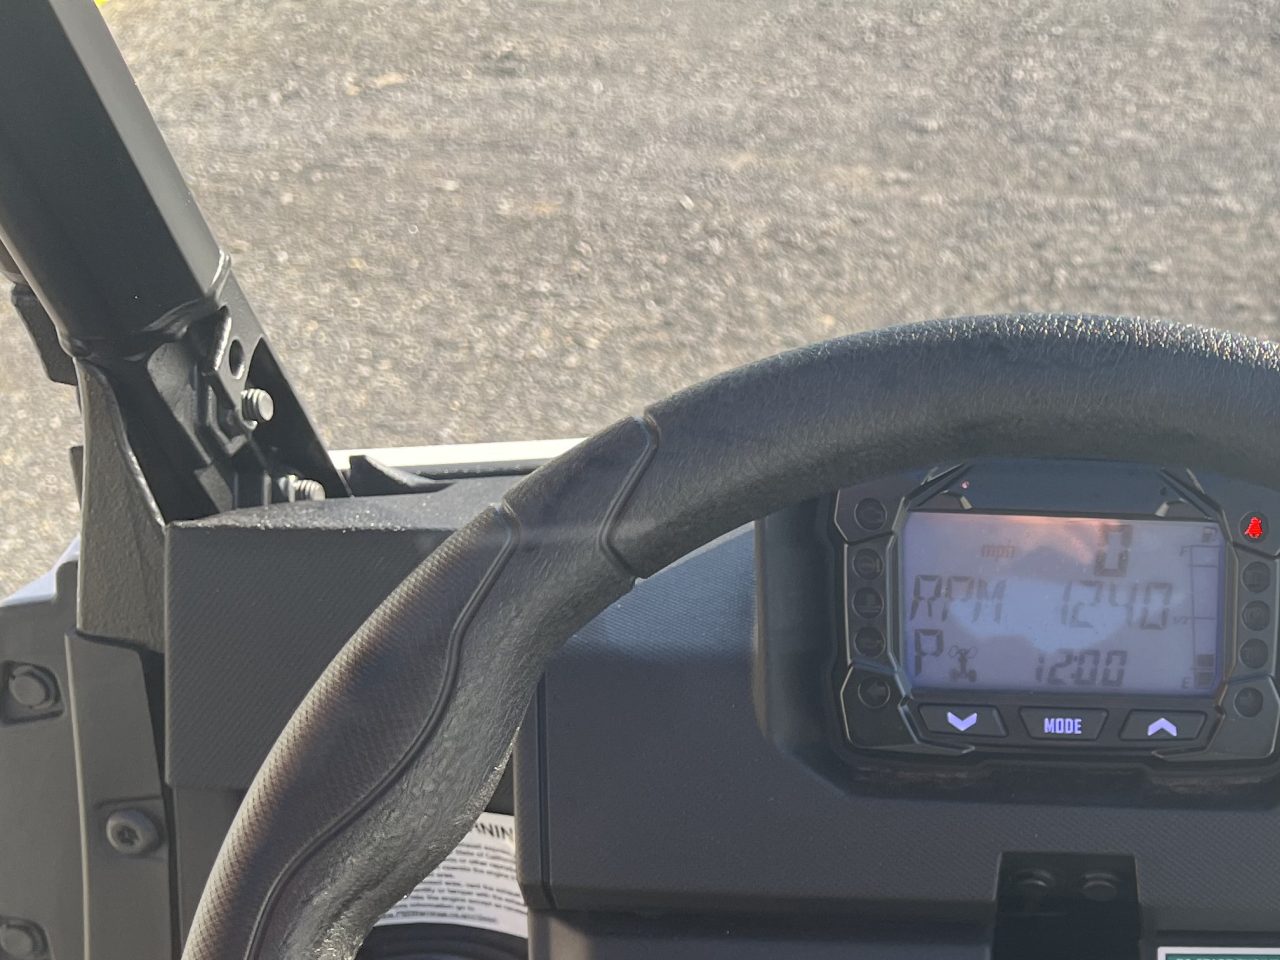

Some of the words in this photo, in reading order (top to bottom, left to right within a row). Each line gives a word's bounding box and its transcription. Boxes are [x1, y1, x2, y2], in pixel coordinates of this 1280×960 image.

[909, 574, 1007, 624] RPM
[1061, 580, 1173, 631] 1240
[914, 628, 945, 677] P
[1044, 717, 1082, 735] MODE
